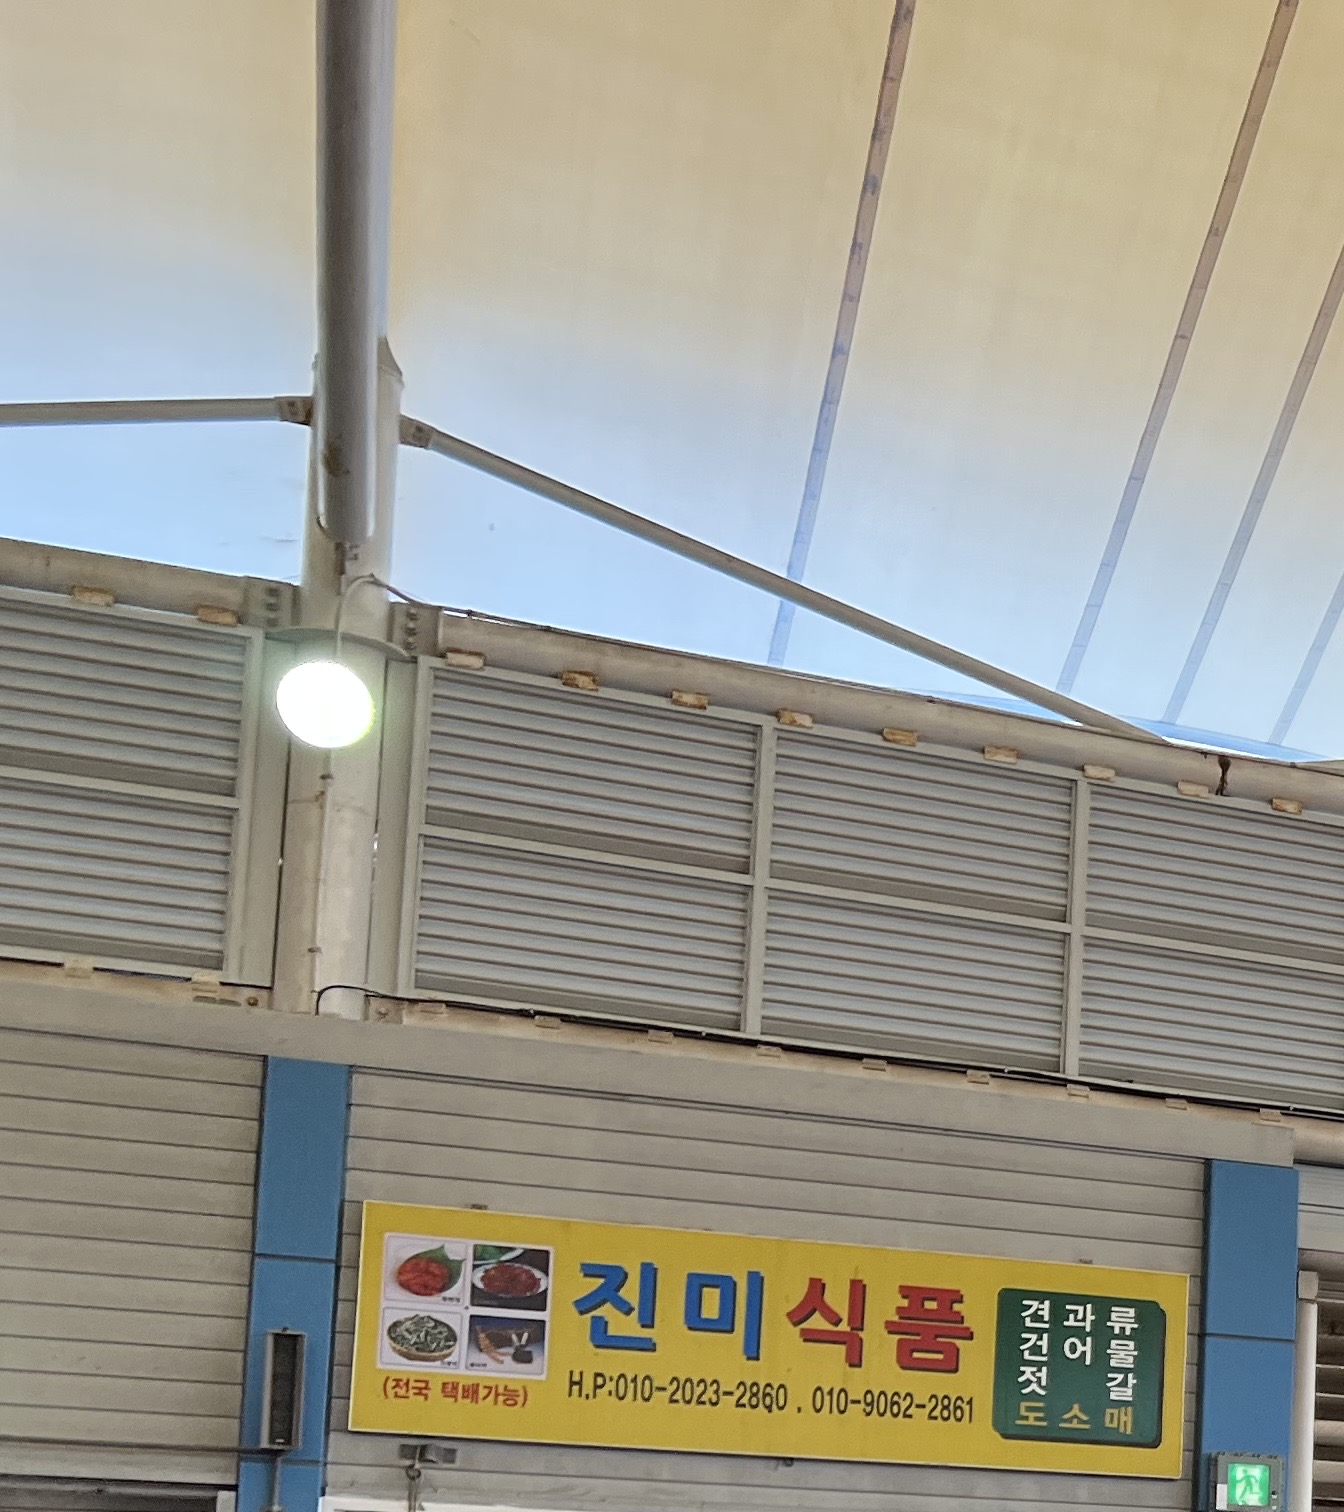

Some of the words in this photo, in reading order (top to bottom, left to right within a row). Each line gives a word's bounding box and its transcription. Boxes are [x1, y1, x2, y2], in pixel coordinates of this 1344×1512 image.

[572, 1260, 974, 1374] 진미식품
[1019, 1298, 1139, 1336] 견과류
[1017, 1332, 1139, 1369] 건어물
[381, 1375, 432, 1402] (전국
[440, 1379, 530, 1408] 택배가능)
[811, 1385, 974, 1424] 010-9062-2861
[1014, 1401, 1134, 1435] 도소매
